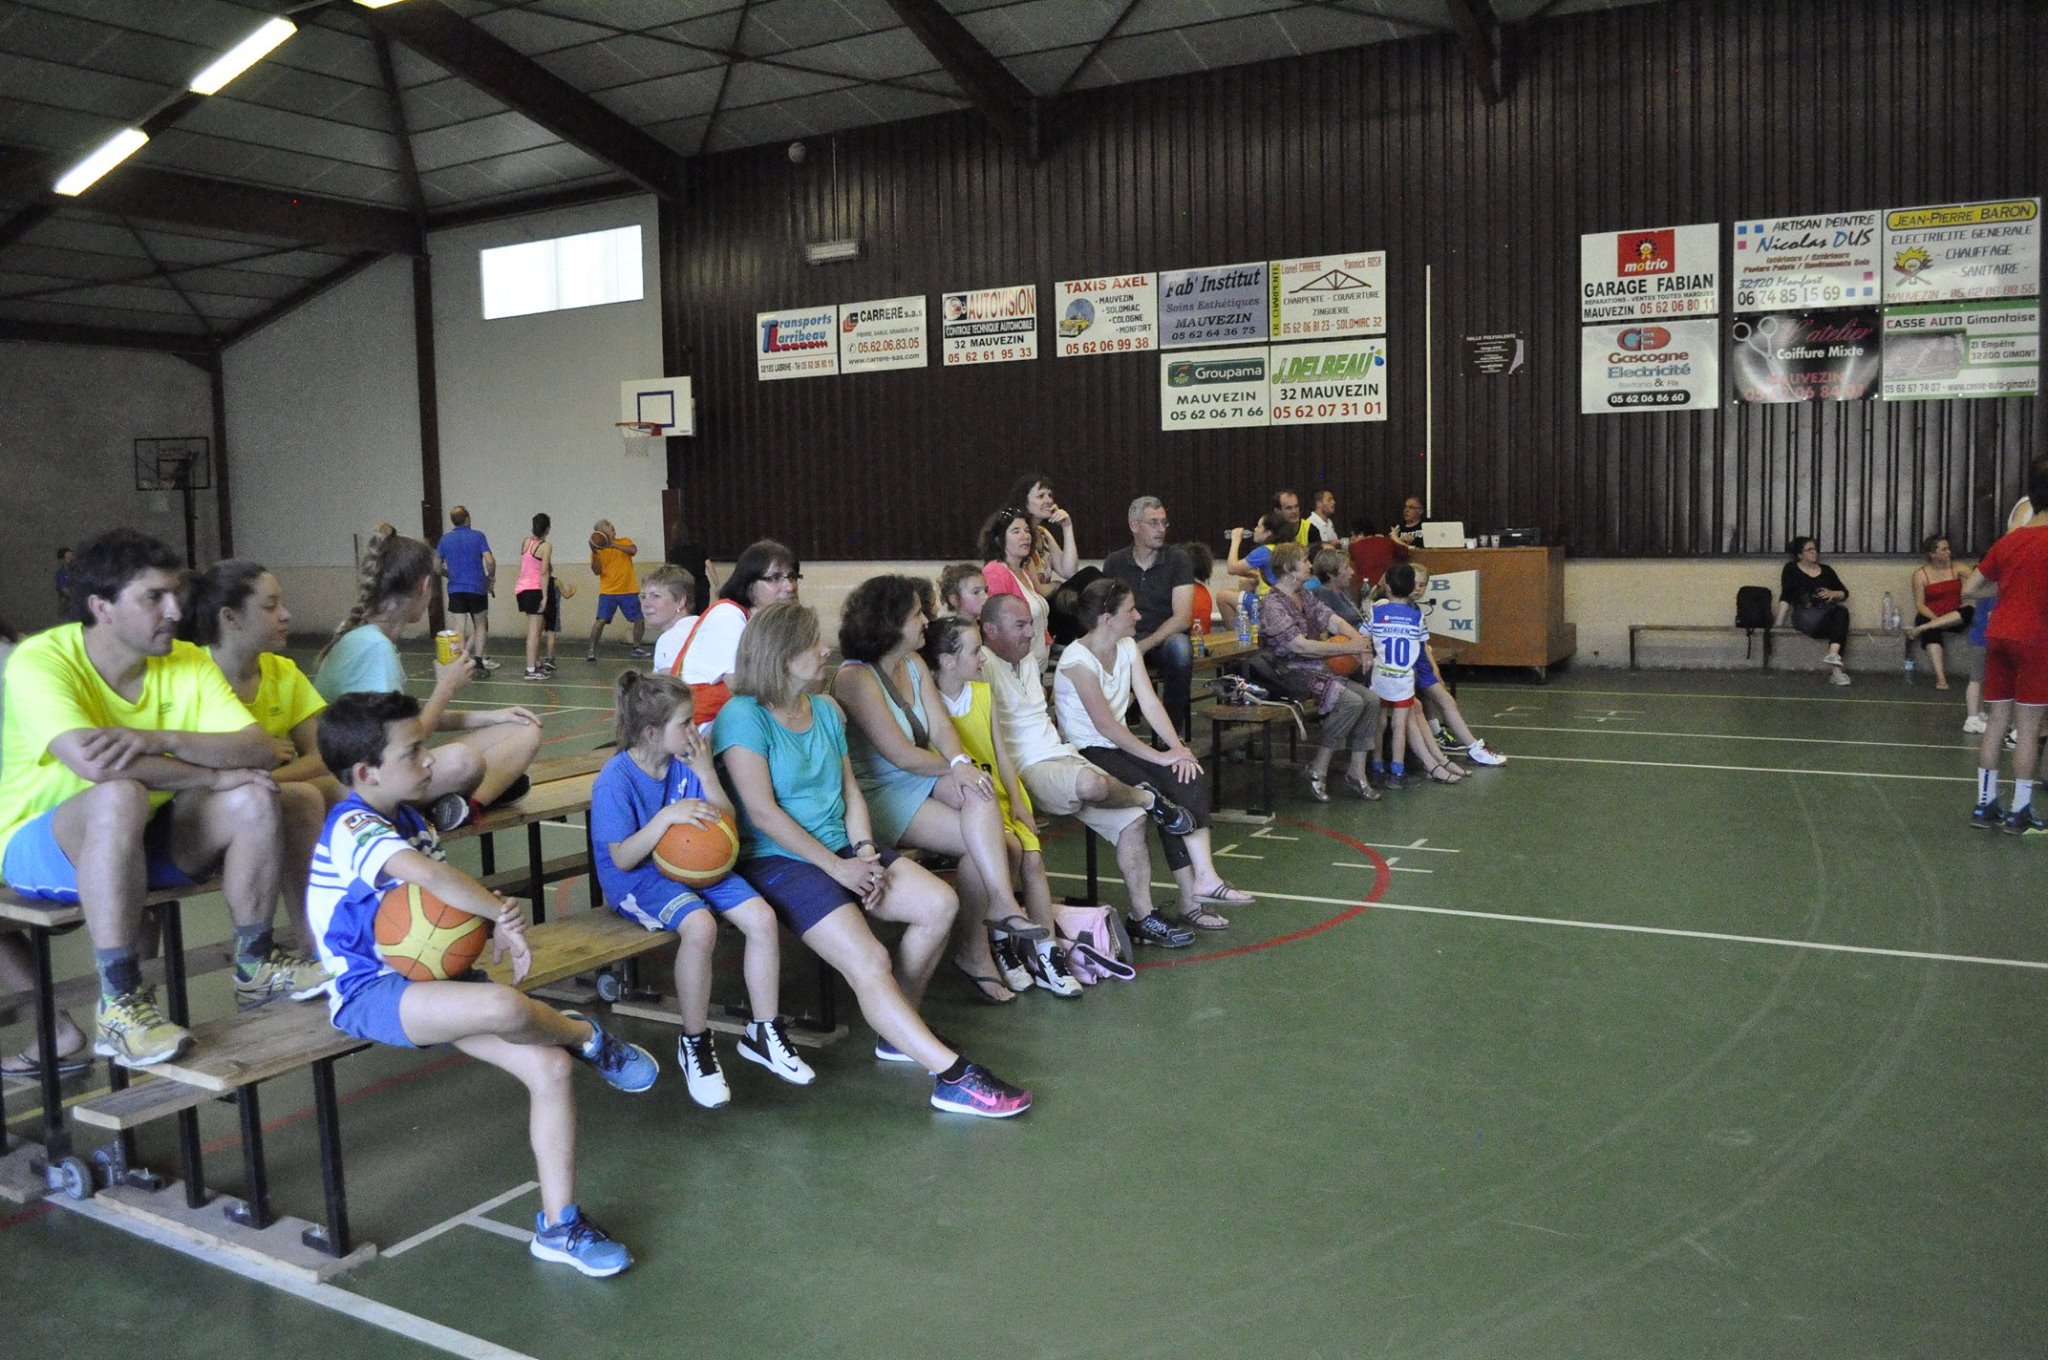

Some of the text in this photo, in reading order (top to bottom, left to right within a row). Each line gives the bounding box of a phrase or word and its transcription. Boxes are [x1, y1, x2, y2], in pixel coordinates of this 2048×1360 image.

[1772, 214, 1875, 232] ARTISAN PEINTRE
[1893, 205, 2031, 227] JEAN-PIERRE BARON
[1756, 228, 1874, 253] Nicolas DUS
[1891, 225, 2034, 245] ELECTRICITE GENERALE
[1945, 244, 2014, 260] CHAUFFAGE
[1624, 259, 1668, 272] motrio
[1960, 263, 2020, 278] SANITAIRE
[1064, 276, 1148, 294] TAXIS AXEL
[1200, 268, 1261, 292] Institut
[1584, 273, 1713, 298] GARAGE FABIAN
[1099, 294, 1134, 304] MAUVEZIN
[1283, 290, 1380, 305] CHARPENTE COUVERTURE
[1738, 285, 1840, 305] 06 74 85 15 69
[969, 287, 1035, 320] AUTOVISION
[1106, 304, 1140, 314] SOLOMIAC
[1166, 303, 1194, 313] Soins
[1584, 305, 1634, 318] MAUVEZIN
[1640, 303, 1652, 314] 05
[1656, 302, 1668, 313] 62
[1672, 300, 1684, 312] 06
[1687, 299, 1699, 311] 80
[860, 307, 903, 322] CARRERE
[1112, 314, 1143, 323] COLOGNE
[1175, 312, 1253, 329] MAUVEZIN
[1886, 313, 2036, 329] CASSE AUTO Gimontoise
[1171, 326, 1256, 340] 05 62 64 36 75
[1321, 320, 1330, 331] 23
[858, 337, 920, 353] 05.62.06.83.05
[954, 335, 1024, 349] 32 MAUVEZIN
[1066, 337, 1149, 355] 05 62 06 99 38
[948, 347, 1032, 363] 05 62 61 95 33
[1608, 352, 1689, 364] Gascogne
[1777, 345, 1864, 360] Coiffure Mixte
[1971, 350, 2036, 360] 32200 GIMONT
[1195, 366, 1262, 380] Groupama
[1607, 363, 1691, 379] Electricité
[1177, 391, 1256, 405] MAUVEZIN
[1280, 383, 1379, 400] 32 MAUVEZIN
[1611, 393, 1684, 404] 05 62 06 86 60
[1170, 407, 1263, 420] 05 62 06 71 66
[1273, 402, 1381, 419] 05 62 07 31 01
[1430, 579, 1451, 591] B
[1442, 599, 1461, 611] C
[1449, 619, 1473, 631] M
[1381, 636, 1410, 667] 10
